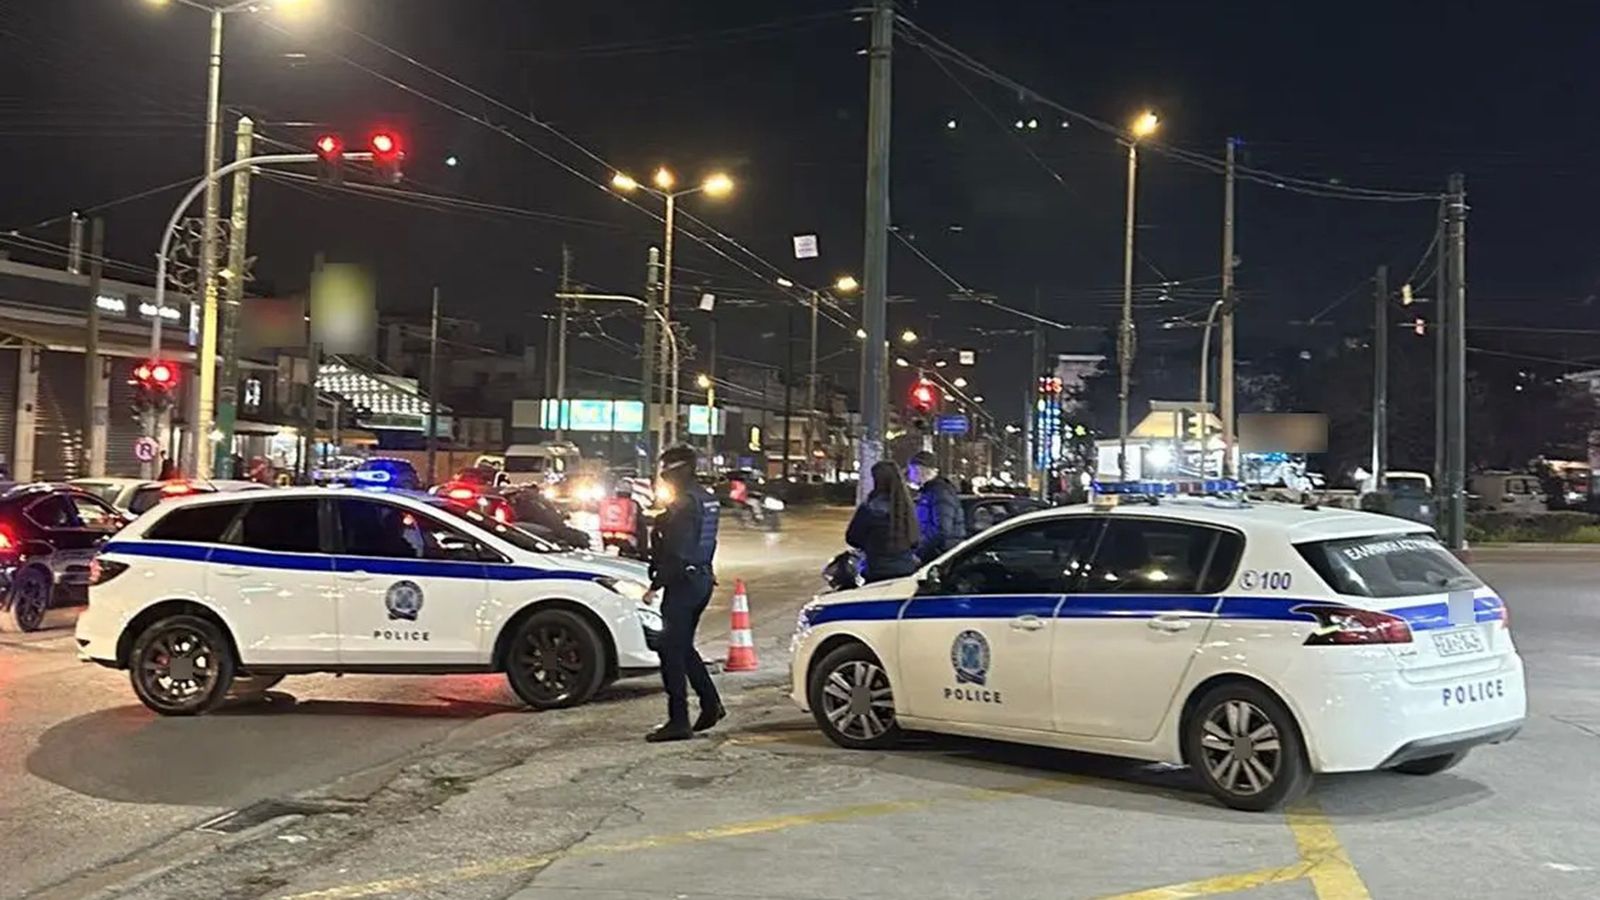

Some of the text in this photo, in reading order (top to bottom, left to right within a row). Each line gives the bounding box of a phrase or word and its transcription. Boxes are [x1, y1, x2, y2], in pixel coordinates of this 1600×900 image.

[1261, 571, 1291, 590] 100
[373, 631, 430, 641] POLICE
[944, 688, 1003, 704] POLICE
[1442, 679, 1504, 706] POLICE
